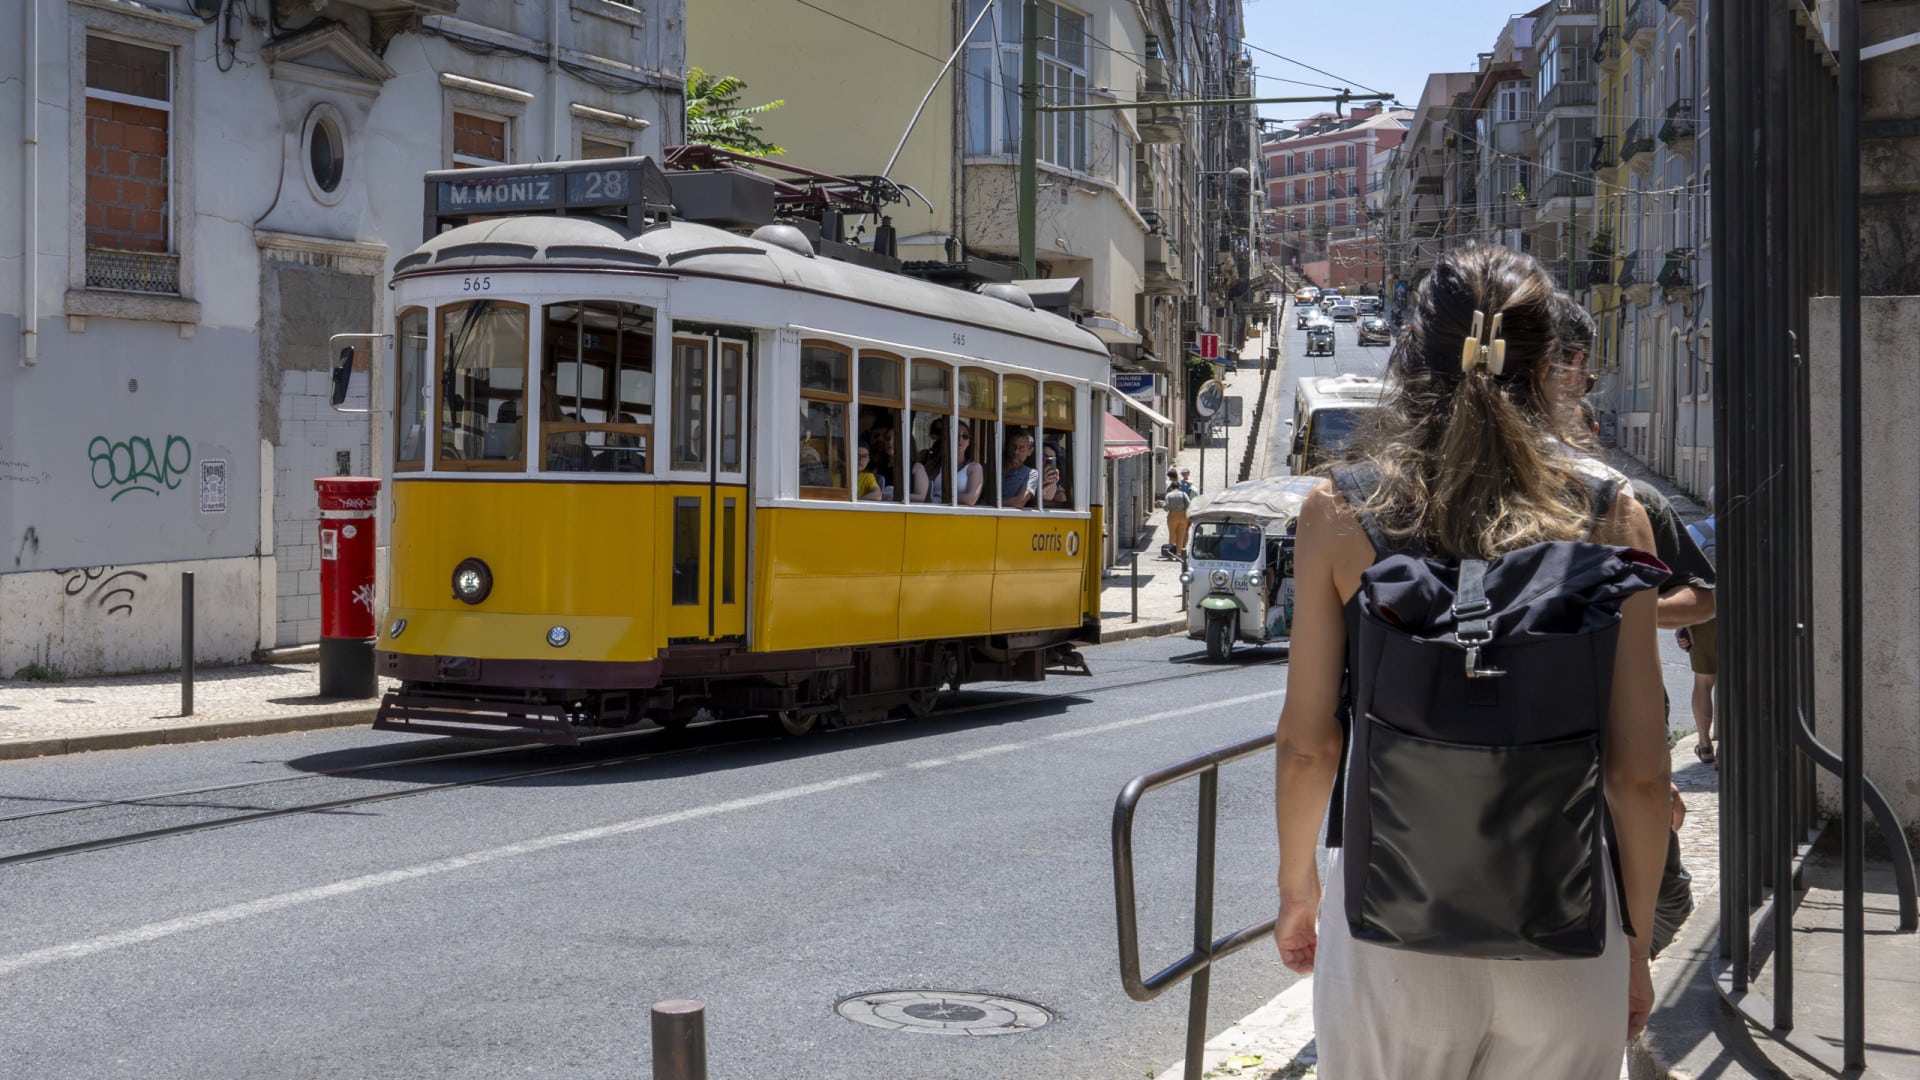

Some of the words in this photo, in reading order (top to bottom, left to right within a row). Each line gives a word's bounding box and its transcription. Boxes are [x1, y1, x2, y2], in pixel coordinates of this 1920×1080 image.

[585, 170, 622, 198] 28
[464, 277, 490, 291] 565
[953, 332, 965, 346] 565
[1032, 527, 1062, 552] carris
